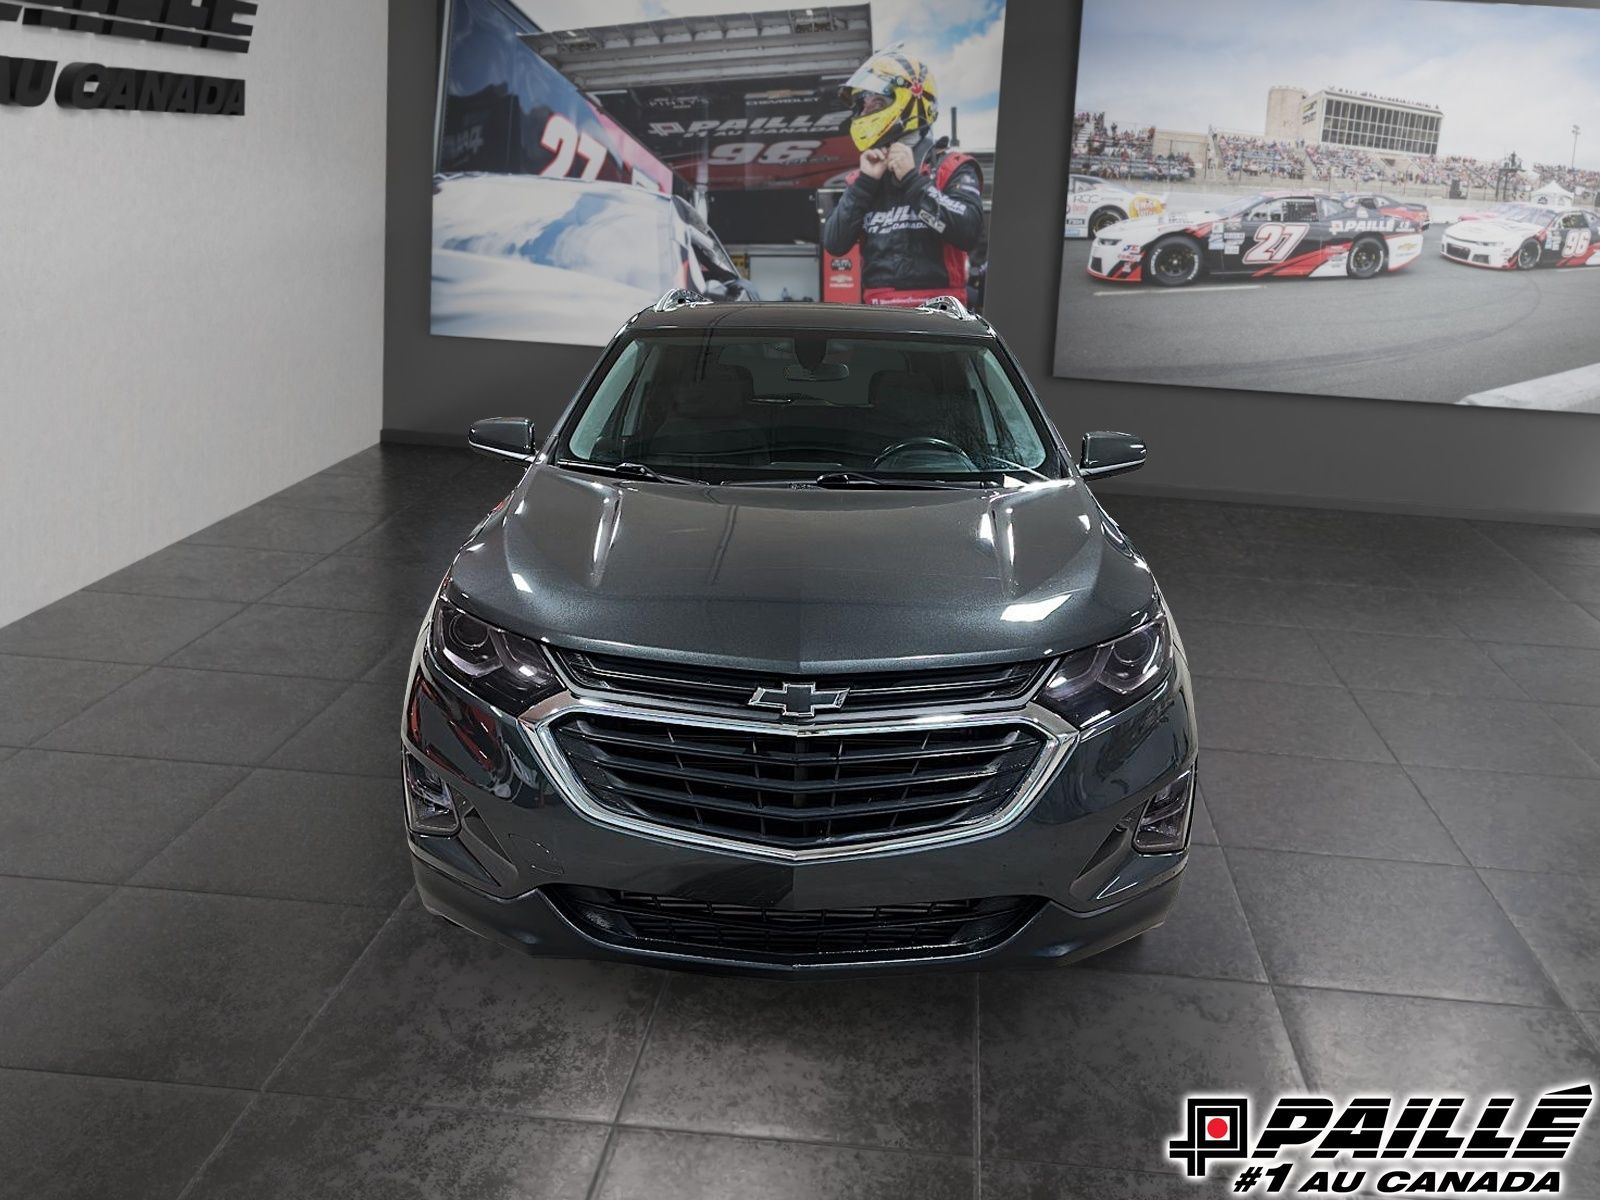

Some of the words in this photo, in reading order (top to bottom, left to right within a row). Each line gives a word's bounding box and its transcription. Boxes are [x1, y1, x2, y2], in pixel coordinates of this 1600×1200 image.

[0, 55, 57, 106] U
[54, 62, 245, 115] CANADA
[540, 113, 608, 181] 27
[749, 126, 839, 135] CANADA
[708, 140, 823, 165] 96
[1242, 222, 1311, 265] 27
[1561, 228, 1592, 258] 96
